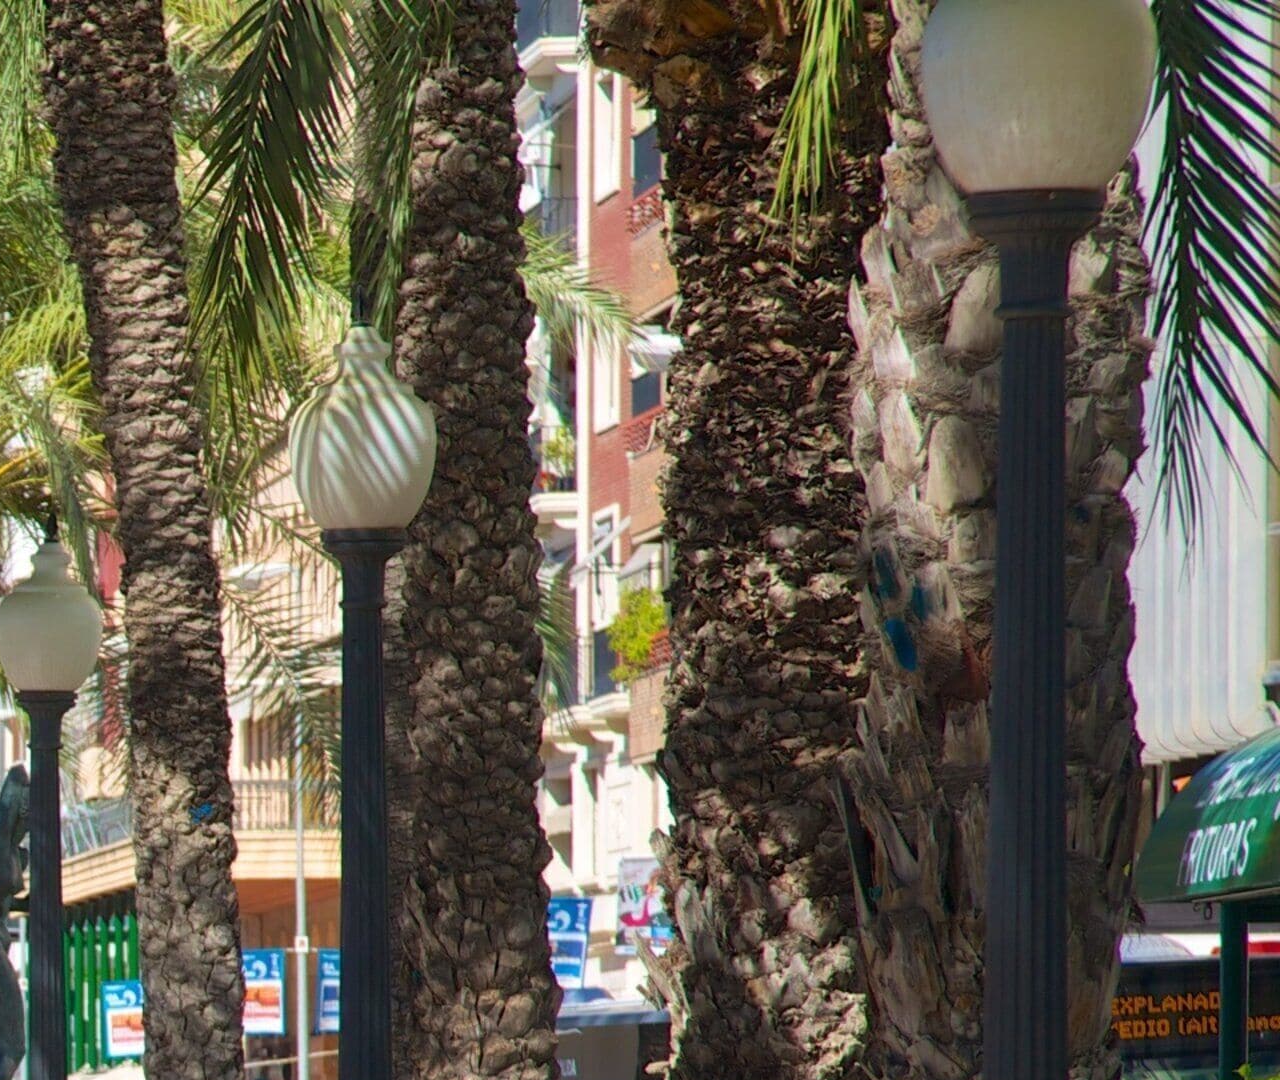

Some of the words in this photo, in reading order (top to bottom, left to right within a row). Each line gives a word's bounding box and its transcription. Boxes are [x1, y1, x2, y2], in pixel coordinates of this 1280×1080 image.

[1176, 818, 1257, 886] FRITURAS
[1111, 992, 1220, 1016] EXPLANAD
[1111, 1018, 1170, 1040] EDIO
